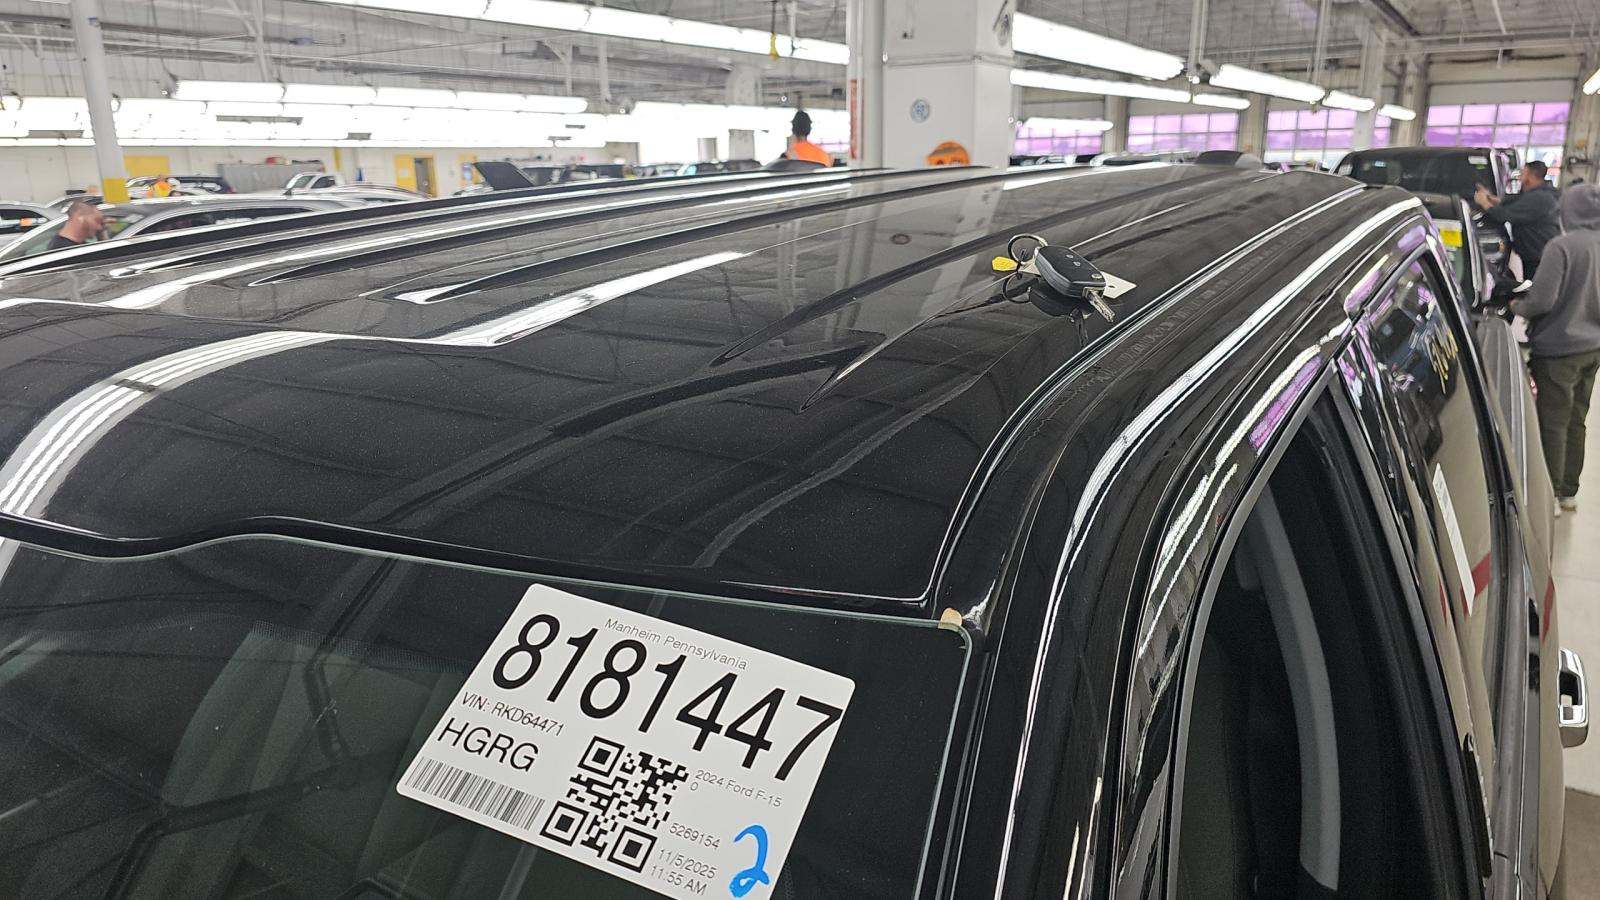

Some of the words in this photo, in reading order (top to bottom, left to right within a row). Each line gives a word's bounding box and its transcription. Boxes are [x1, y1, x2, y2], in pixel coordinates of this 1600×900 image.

[604, 618, 661, 644] Manheim
[664, 635, 748, 670] Pennsylvania
[462, 691, 490, 712] VIN:
[491, 701, 564, 737] RKD64471
[492, 613, 845, 782] 8181447
[437, 717, 539, 772] HGRG
[695, 769, 724, 786] 2024
[725, 779, 753, 797] Ford
[755, 791, 782, 808] F-15
[669, 823, 720, 849] 5269154
[651, 866, 684, 886] 11:55
[685, 878, 708, 896] AM
[659, 848, 717, 879] 11/5/2025
[729, 824, 770, 898] 2
